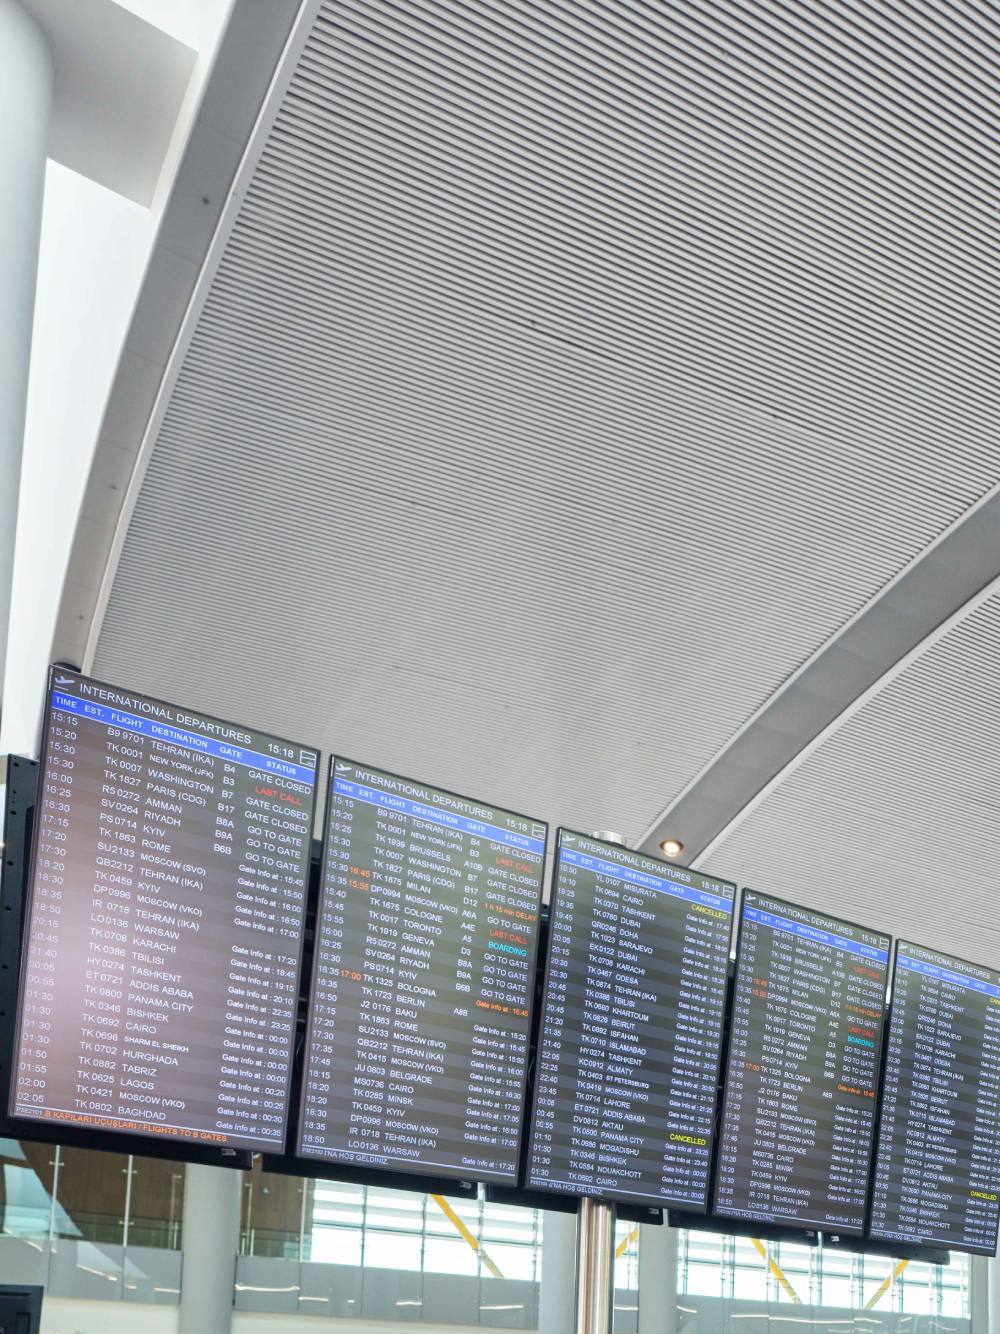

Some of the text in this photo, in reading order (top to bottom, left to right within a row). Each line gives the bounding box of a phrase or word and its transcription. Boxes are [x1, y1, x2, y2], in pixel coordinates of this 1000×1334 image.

[55, 696, 296, 775] TIME EST. FLIGHT DESTINATION GATE STATUS
[79, 682, 294, 759] INTERNATIONAL DEPARTURES 15:18
[49, 725, 76, 741] 15:20
[149, 754, 167, 766] NEW
[169, 760, 193, 773] YORK
[194, 767, 214, 780] (JFK)
[222, 776, 235, 786] B3
[255, 784, 278, 799] LAST
[278, 791, 301, 805] CALL
[51, 711, 78, 726] 15:15
[151, 740, 190, 759] TEHRAN
[191, 752, 214, 767] (IKA)
[223, 763, 235, 774] B4
[248, 769, 273, 784] GATE
[274, 777, 311, 795] CLOSED
[46, 754, 74, 769] 15:30
[146, 782, 176, 798] PARIS
[178, 790, 206, 807] (CDG)
[217, 802, 235, 814] B17
[244, 809, 269, 823] GATE
[270, 817, 307, 834] CLOSED
[48, 739, 75, 755] 15:30
[147, 768, 214, 794] WASHINGTON
[221, 789, 233, 799] B7
[245, 796, 270, 810] GATE
[271, 803, 308, 821] CLOSED
[335, 781, 353, 793] TIME
[379, 795, 405, 809] FLIGHT
[412, 805, 457, 825] DESTINATION
[467, 822, 485, 833] GATE
[504, 833, 529, 847] STATUS
[355, 769, 527, 831] INTERNATIONAL DEPARTURES 15:18
[41, 813, 69, 827] 17:15
[141, 838, 171, 853] ROME
[238, 863, 255, 874] Gate
[257, 868, 271, 878] Info
[271, 872, 278, 880] at
[283, 875, 303, 887] 15:45
[577, 839, 690, 883] INTERNATIONAL DEPARTURES
[623, 882, 727, 920] MISURATA CANCELLED
[758, 899, 852, 936] INTERNATIONAL DEPARTURES
[322, 912, 344, 924] 15:55
[401, 932, 435, 947] GENEVA
[484, 952, 496, 962] GO
[497, 955, 508, 965] TO
[509, 958, 528, 969] GATE
[323, 899, 345, 912] 15:45
[403, 919, 441, 935] TORONTO
[488, 940, 527, 957] BOARDING
[616, 962, 645, 975] KARACHI
[909, 947, 990, 980] INTERNATIONAL DEPARTURES
[340, 969, 361, 981] 17:00
[397, 982, 436, 997] BOLOGNA
[612, 1007, 649, 1022] KHARTOUM
[788, 1019, 815, 1032] TORONTO
[789, 1009, 817, 1022] COLOGNE
[607, 1052, 642, 1066] TASHKENT
[608, 1041, 646, 1056] ISLAMABAD
[310, 1055, 330, 1066] 17:45
[389, 1069, 433, 1084] BELGRADE
[18, 1076, 45, 1088] 02:00
[118, 1091, 160, 1105] MOSCOW
[161, 1098, 185, 1110] (VKO)
[603, 1098, 630, 1109] LAHORE
[782, 1082, 803, 1092] BERLIN
[16, 1091, 44, 1103] 02:05
[117, 1105, 166, 1120] BAGHDAD
[143, 1123, 177, 1135] FLIGHTS
[179, 1128, 191, 1137] TO
[200, 1131, 228, 1142] GATES
[304, 1120, 325, 1131] 18:35
[384, 1132, 417, 1144] TEHRAN
[418, 1137, 436, 1148] (IKA)
[601, 1120, 623, 1131] AKTAU
[669, 1133, 705, 1145] CANCELLED
[970, 1190, 997, 1201] CANCELLED
